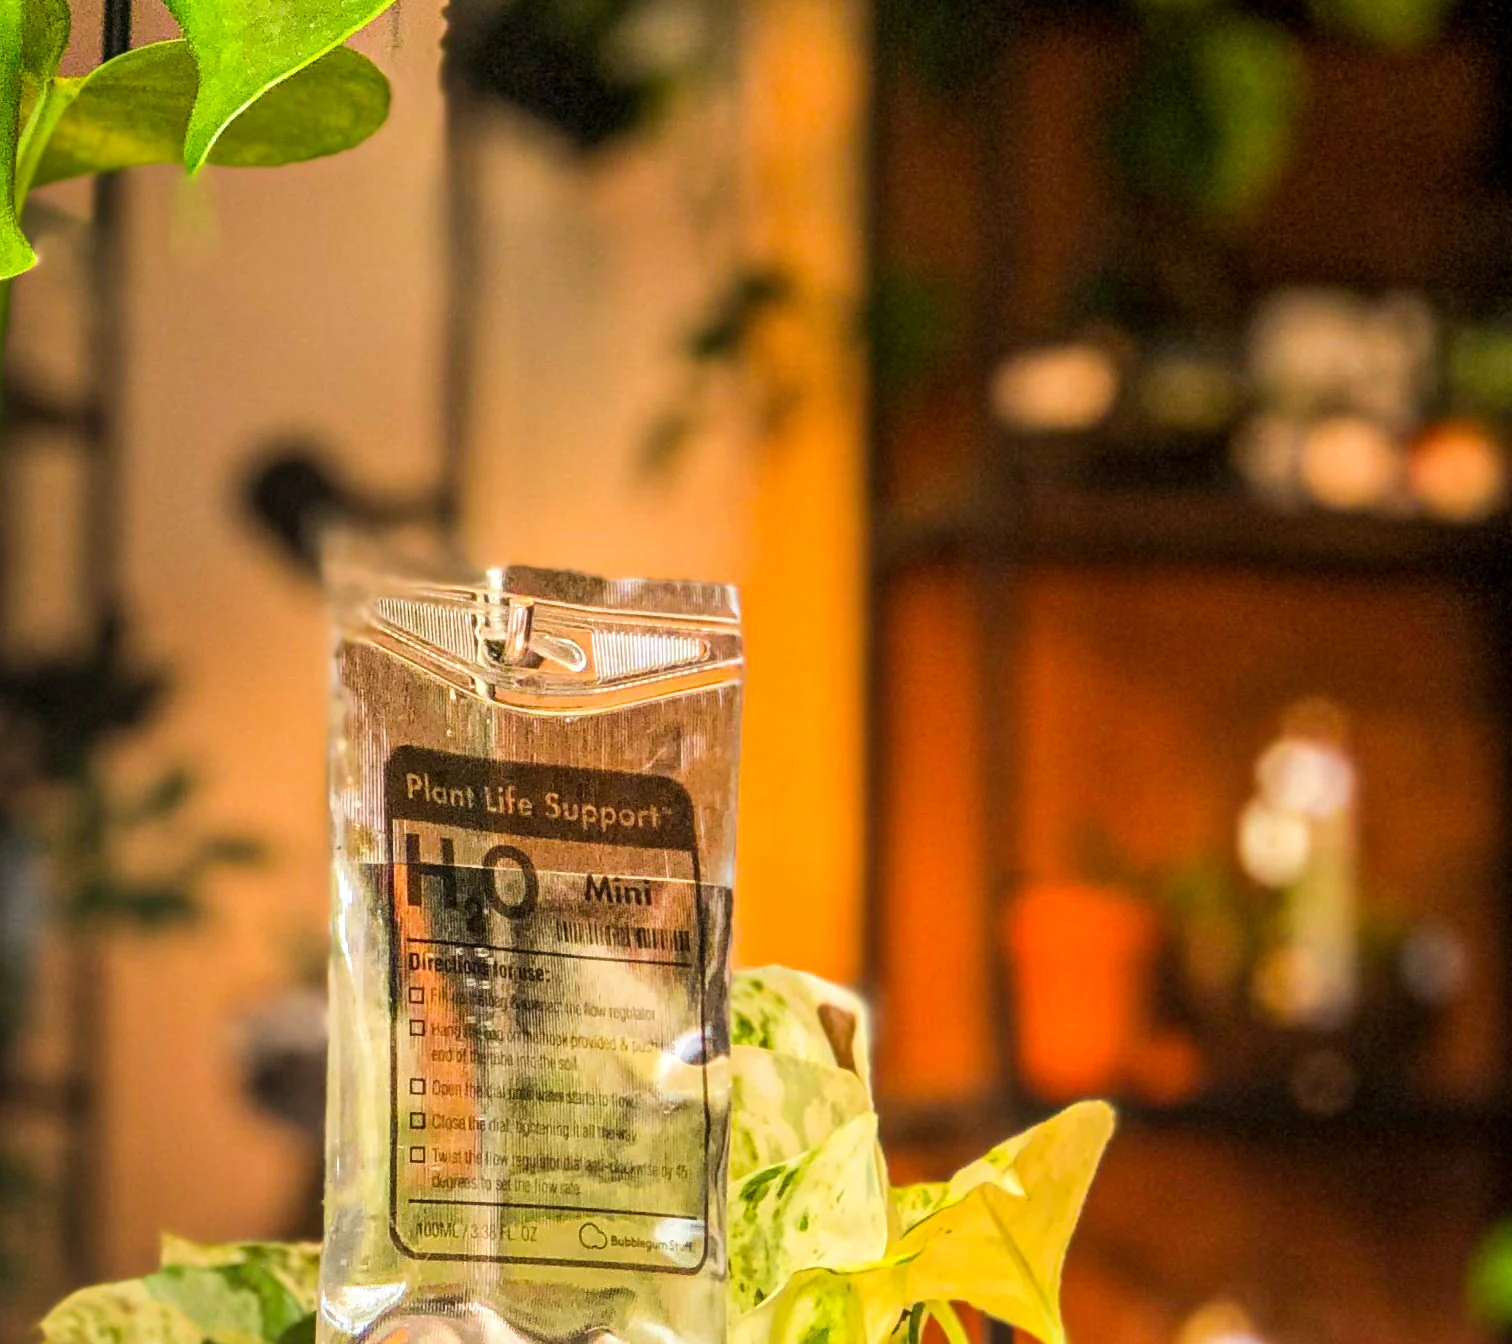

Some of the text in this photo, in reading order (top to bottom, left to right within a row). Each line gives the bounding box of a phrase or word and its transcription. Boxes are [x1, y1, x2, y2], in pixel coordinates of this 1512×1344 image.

[405, 772, 474, 809] Plant
[486, 784, 534, 816] Life
[584, 873, 653, 906] Mini
[408, 952, 551, 983] Directions for use:
[431, 1079, 462, 1098] Open
[431, 1113, 466, 1130] Close
[431, 1147, 462, 1164] Twist
[610, 1234, 693, 1253] Bubblegum Stuff
